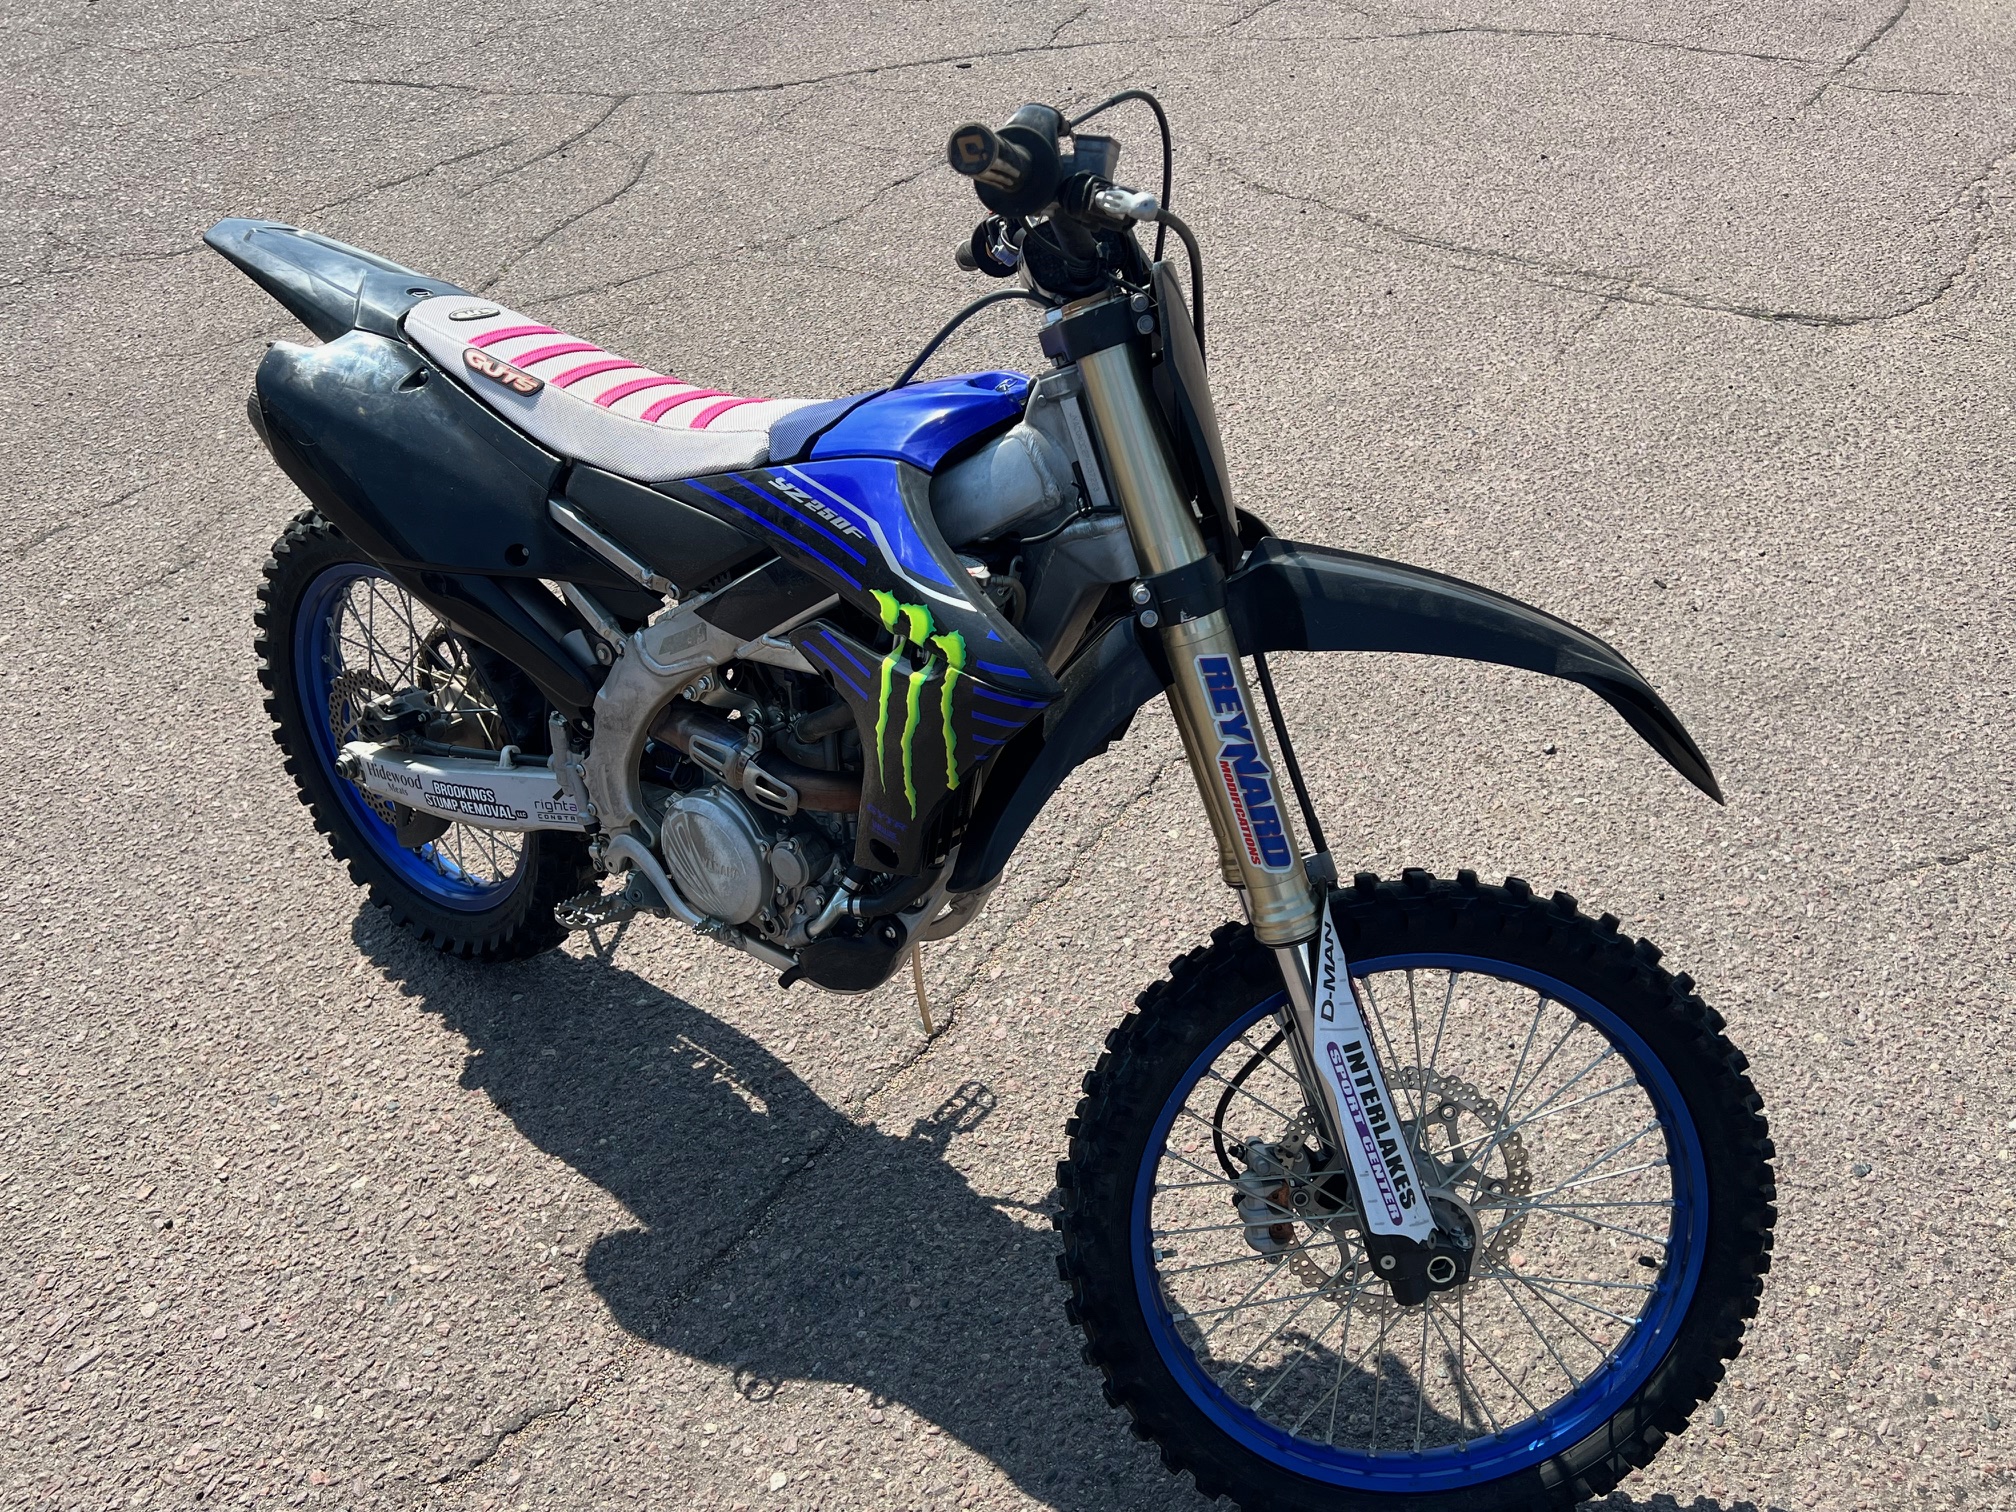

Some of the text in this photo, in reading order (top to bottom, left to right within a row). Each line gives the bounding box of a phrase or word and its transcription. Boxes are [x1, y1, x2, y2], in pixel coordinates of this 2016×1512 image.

[465, 349, 541, 393] GUTS
[767, 476, 867, 539] YZ250F
[366, 761, 423, 790] Hidewood
[433, 781, 495, 804] BROOKINGS
[1198, 656, 1292, 868] REYNARD
[425, 793, 459, 811] STUMP
[461, 801, 516, 820] REMOVAL
[1219, 760, 1262, 866] MODIFICATIONS
[1320, 921, 1334, 1023] D-MAN
[1330, 1049, 1400, 1224] SPORT CENTER
[1342, 1040, 1416, 1210] INTERLAKES
